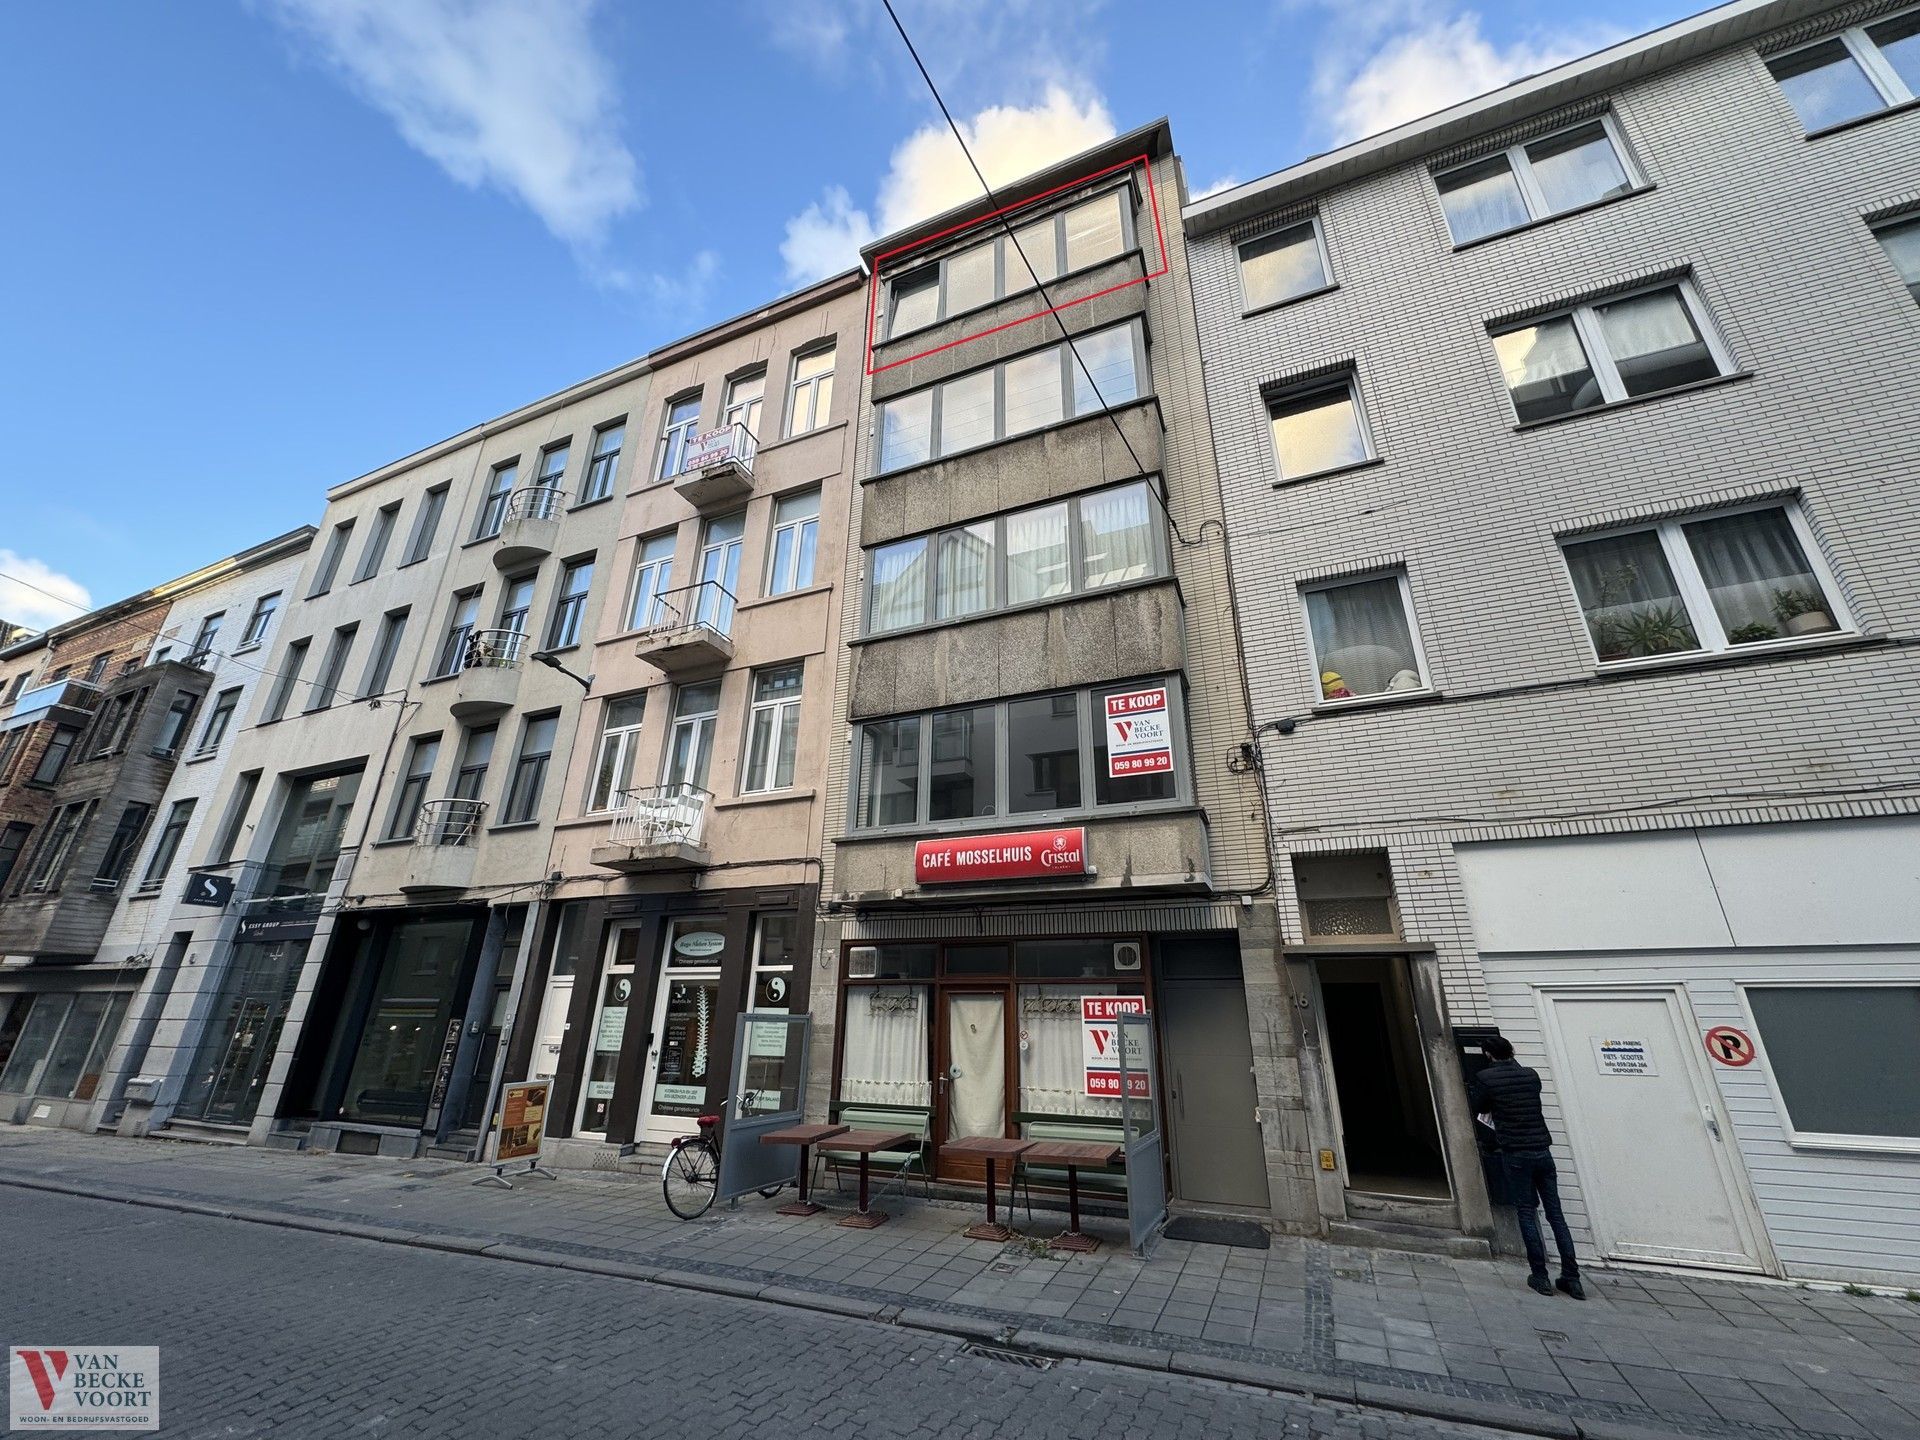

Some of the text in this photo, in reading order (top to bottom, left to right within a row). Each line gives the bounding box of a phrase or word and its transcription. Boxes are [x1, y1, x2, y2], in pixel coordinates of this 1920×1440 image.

[1111, 694, 1161, 711] TE KOOP
[1134, 724, 1160, 733] BECKE
[1135, 730, 1163, 739] VOORT
[1114, 756, 1167, 770] 059 80 99 20
[922, 846, 1032, 868] CAFÉ MOSSELHUIS
[1041, 849, 1080, 867] Cristal
[1087, 1002, 1140, 1015] TE KOOP
[1112, 1046, 1142, 1055] VORT
[1090, 1078, 1106, 1088] 059
[1108, 1079, 1119, 1089] 80
[1135, 1080, 1146, 1089] 20
